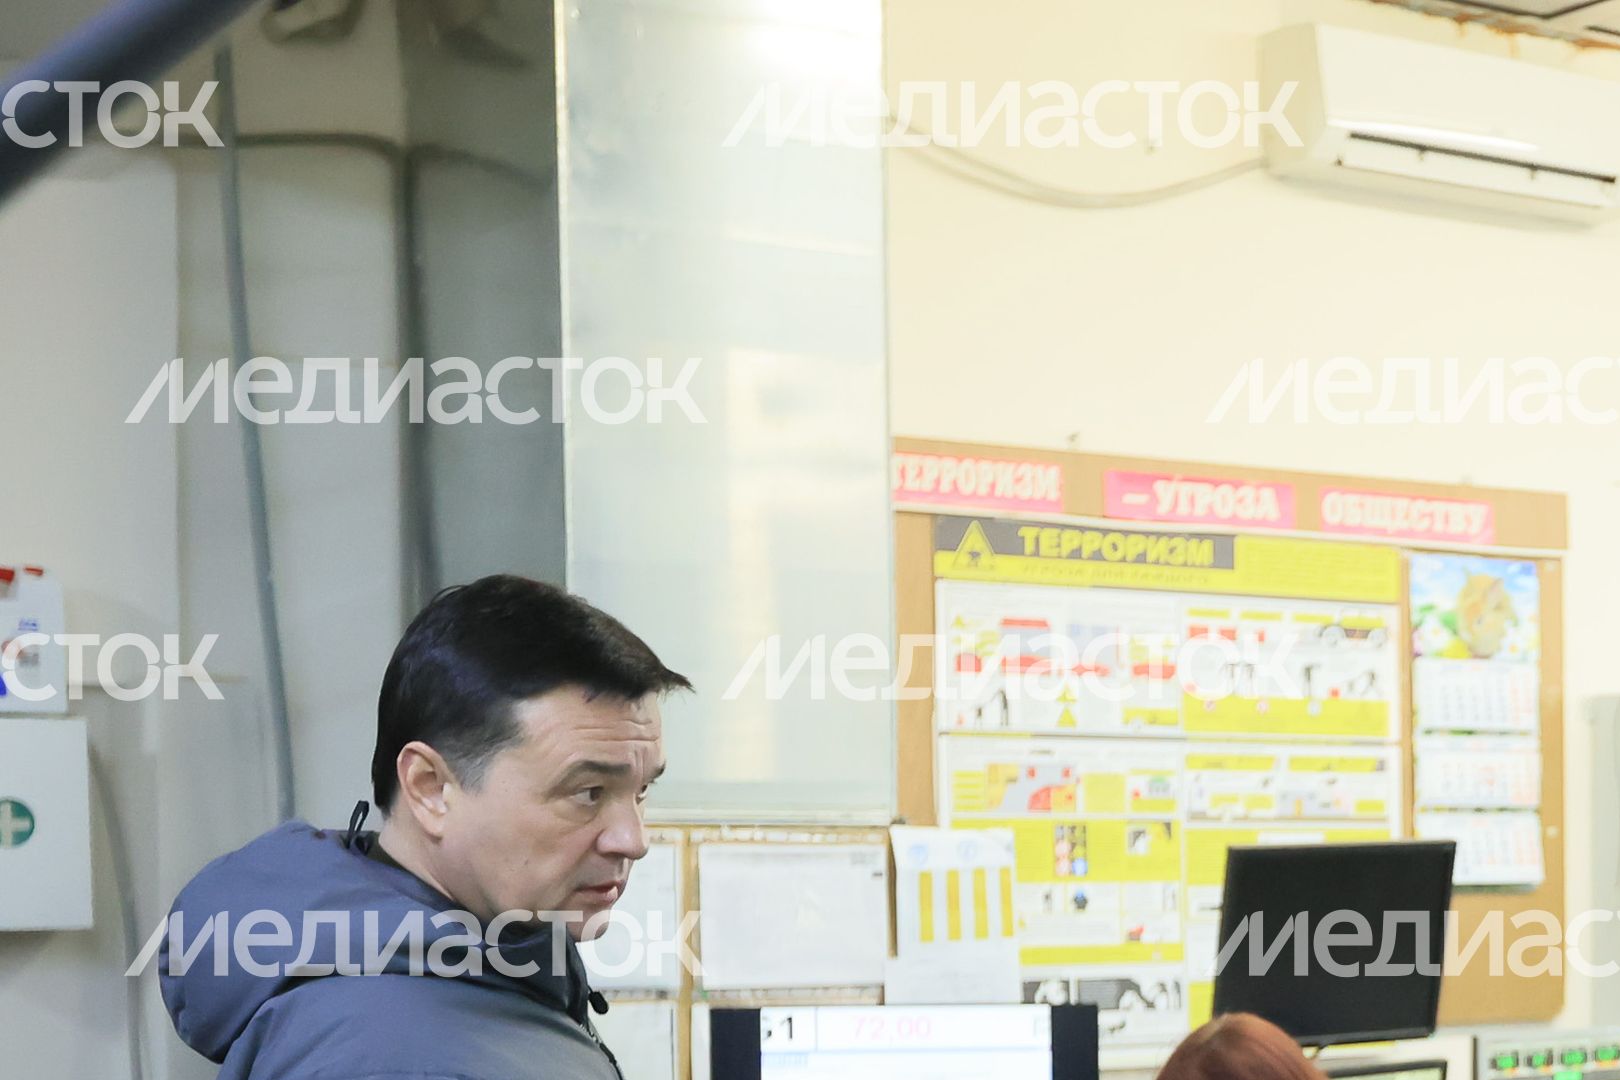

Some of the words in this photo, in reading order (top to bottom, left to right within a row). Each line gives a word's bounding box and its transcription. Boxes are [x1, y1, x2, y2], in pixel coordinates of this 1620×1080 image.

[1152, 477, 1282, 522] УГРОЗА
[1321, 491, 1490, 536] ОБЩЕСТВУ
[1017, 525, 1216, 568] ТЕРРОРИЗМ
